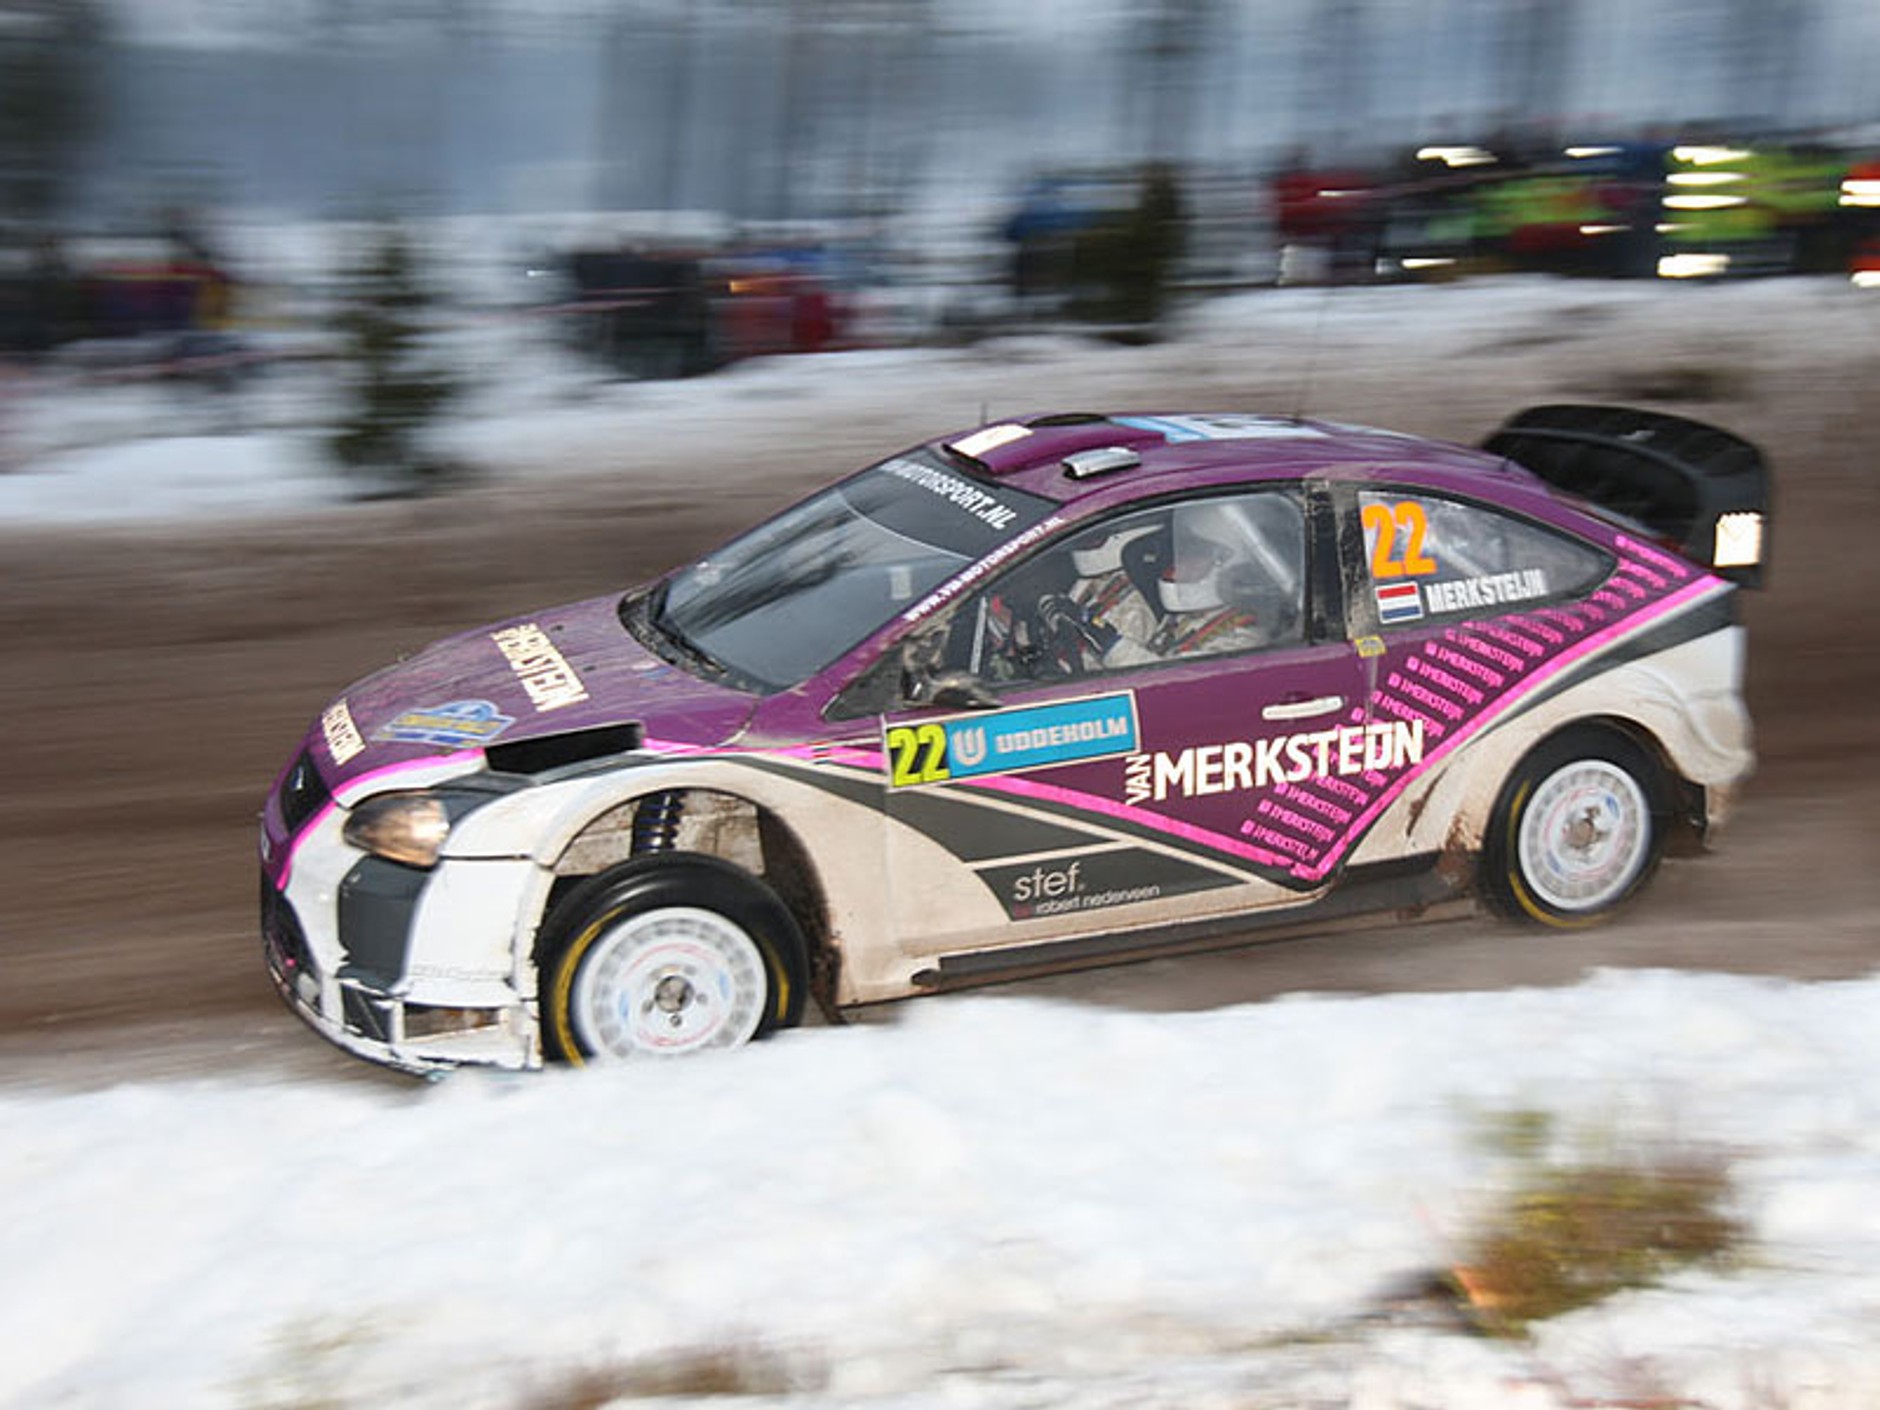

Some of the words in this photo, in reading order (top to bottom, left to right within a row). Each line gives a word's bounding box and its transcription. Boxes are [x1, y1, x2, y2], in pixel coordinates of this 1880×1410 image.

[1362, 501, 1437, 579] 22
[1425, 569, 1549, 613] MERKSTEIJN
[887, 724, 950, 786] 22
[994, 716, 1128, 753] UDDEHOLM
[1125, 754, 1153, 805] VAN
[1154, 719, 1424, 801] MERKSTEIJN
